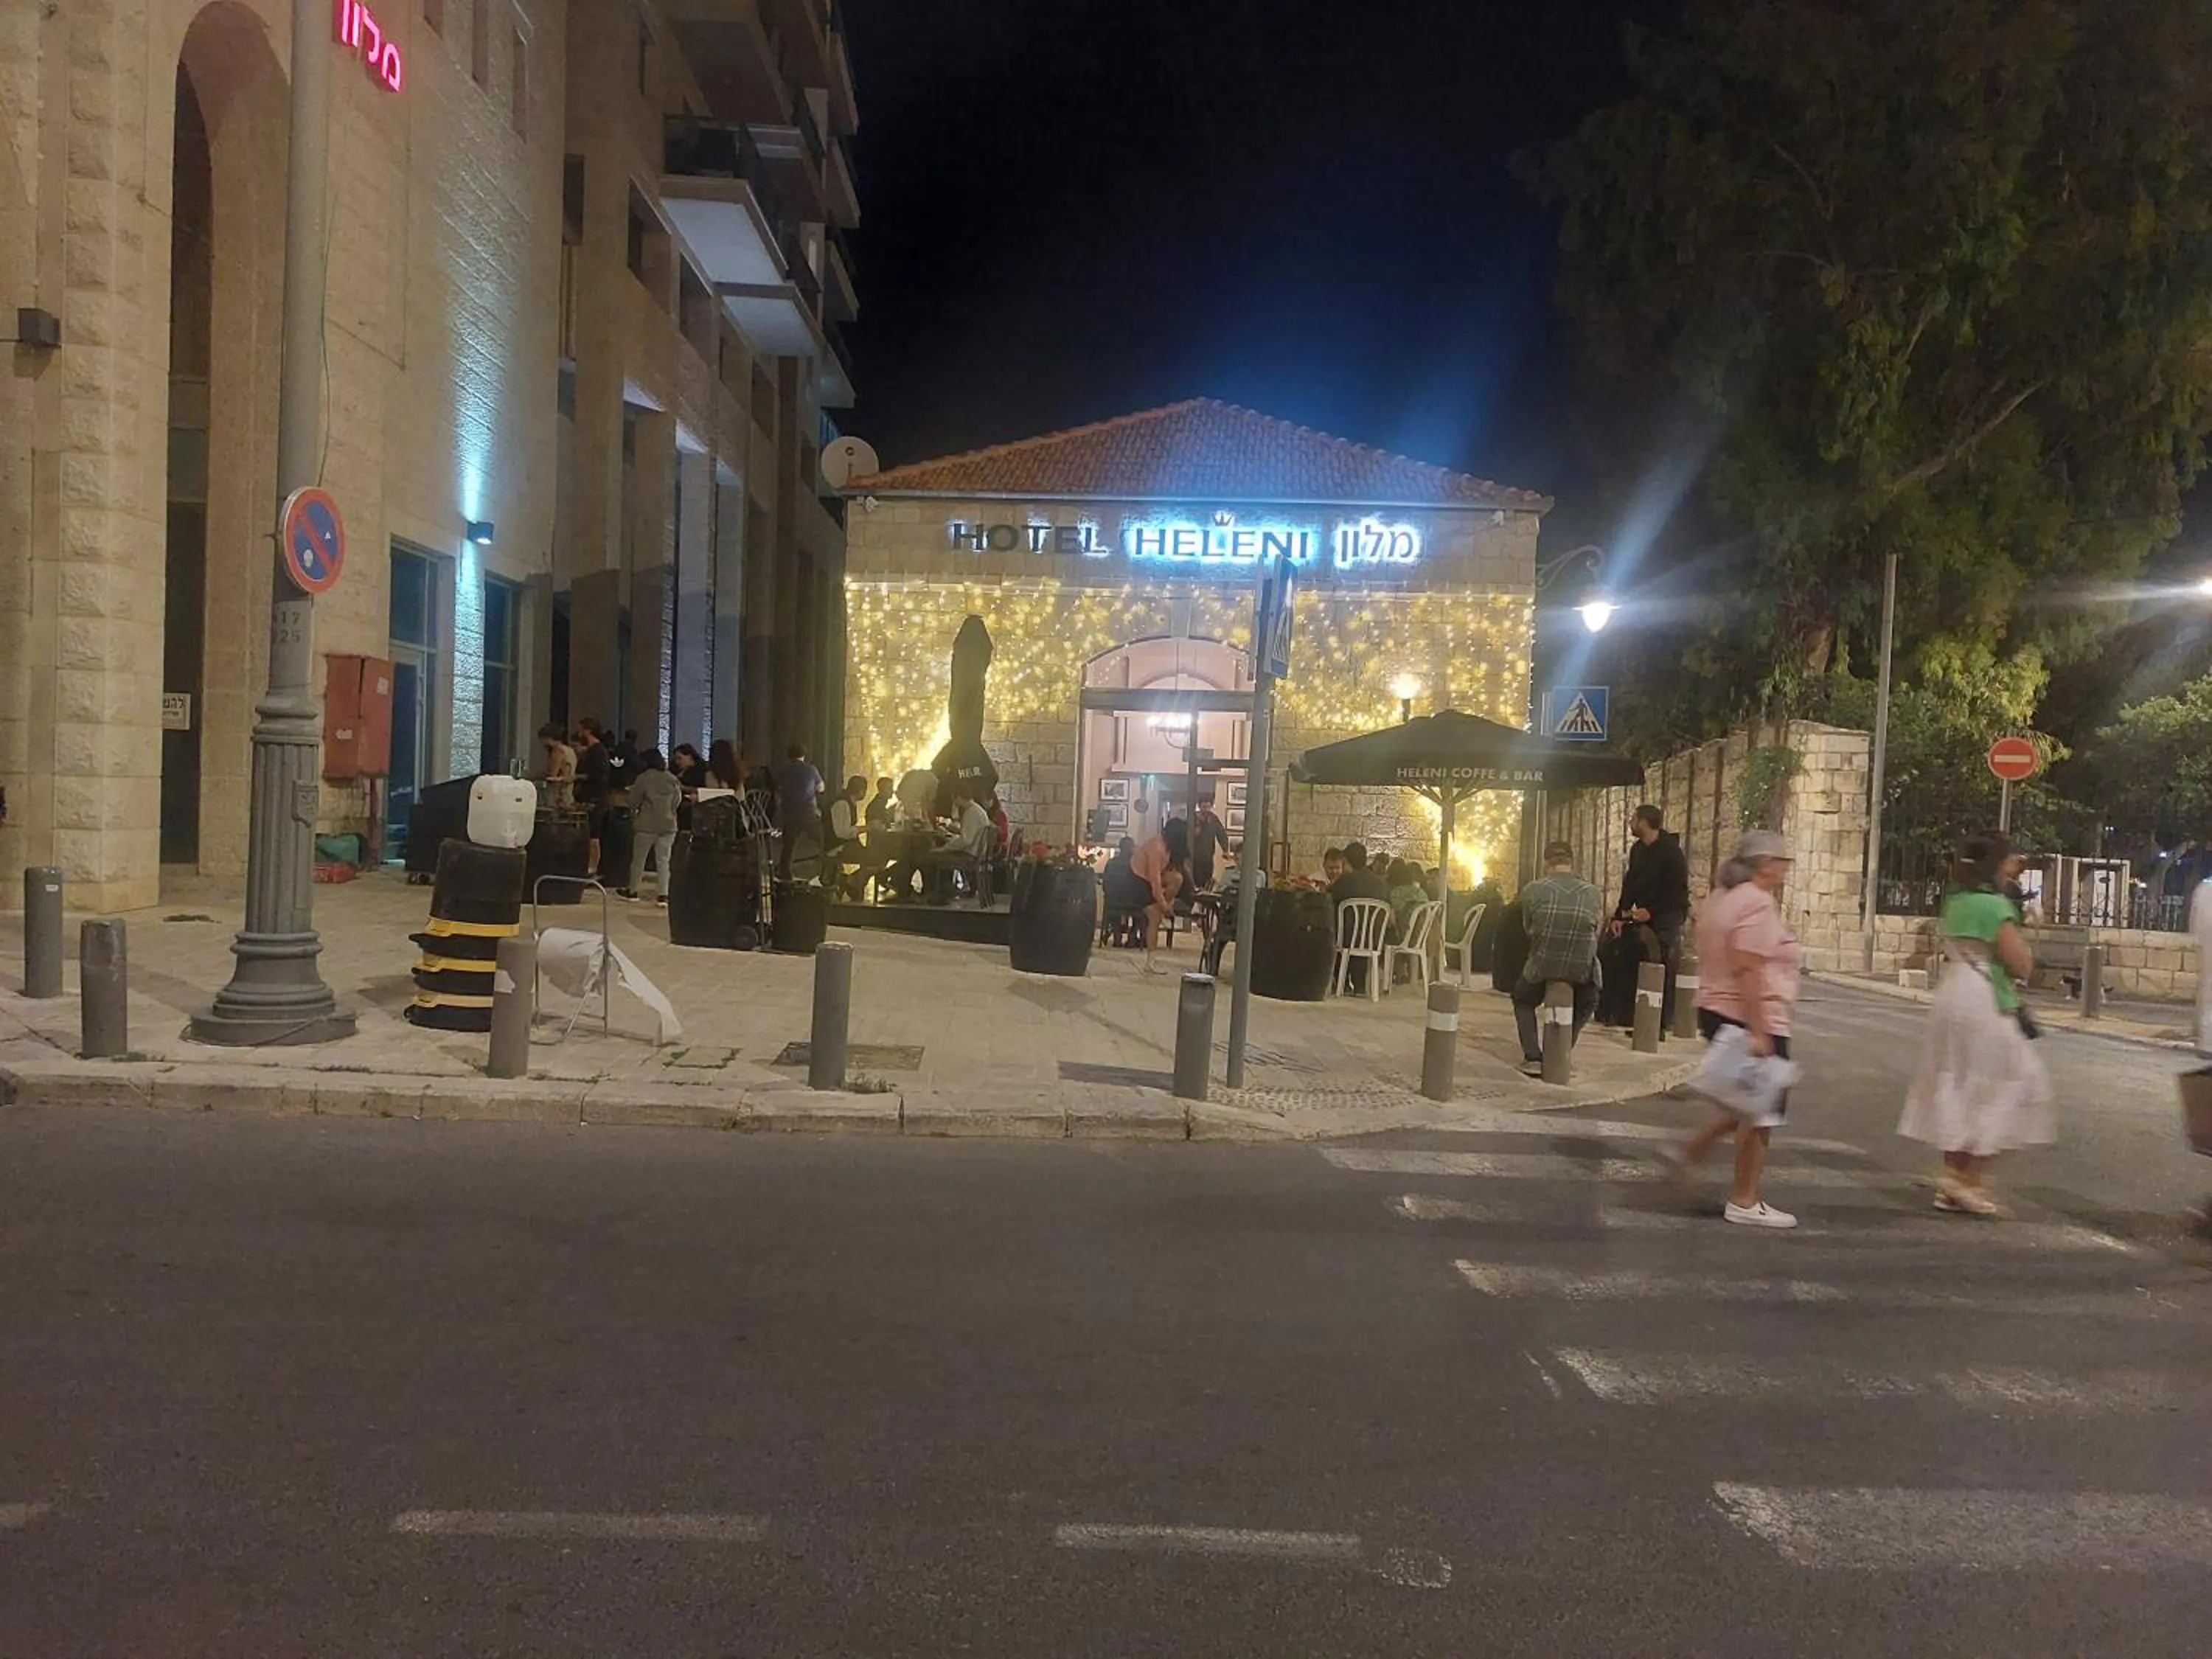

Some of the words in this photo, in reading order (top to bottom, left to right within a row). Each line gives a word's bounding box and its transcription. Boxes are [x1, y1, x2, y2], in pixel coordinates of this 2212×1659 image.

[341, 0, 401, 92] מלון
[953, 522, 1108, 554] HOTEL
[1135, 528, 1310, 559] HELENI
[1340, 524, 1414, 563] מלון
[1397, 767, 1447, 779] HELENI
[1450, 767, 1496, 779] COFFE
[1513, 771, 1544, 782] BAR
